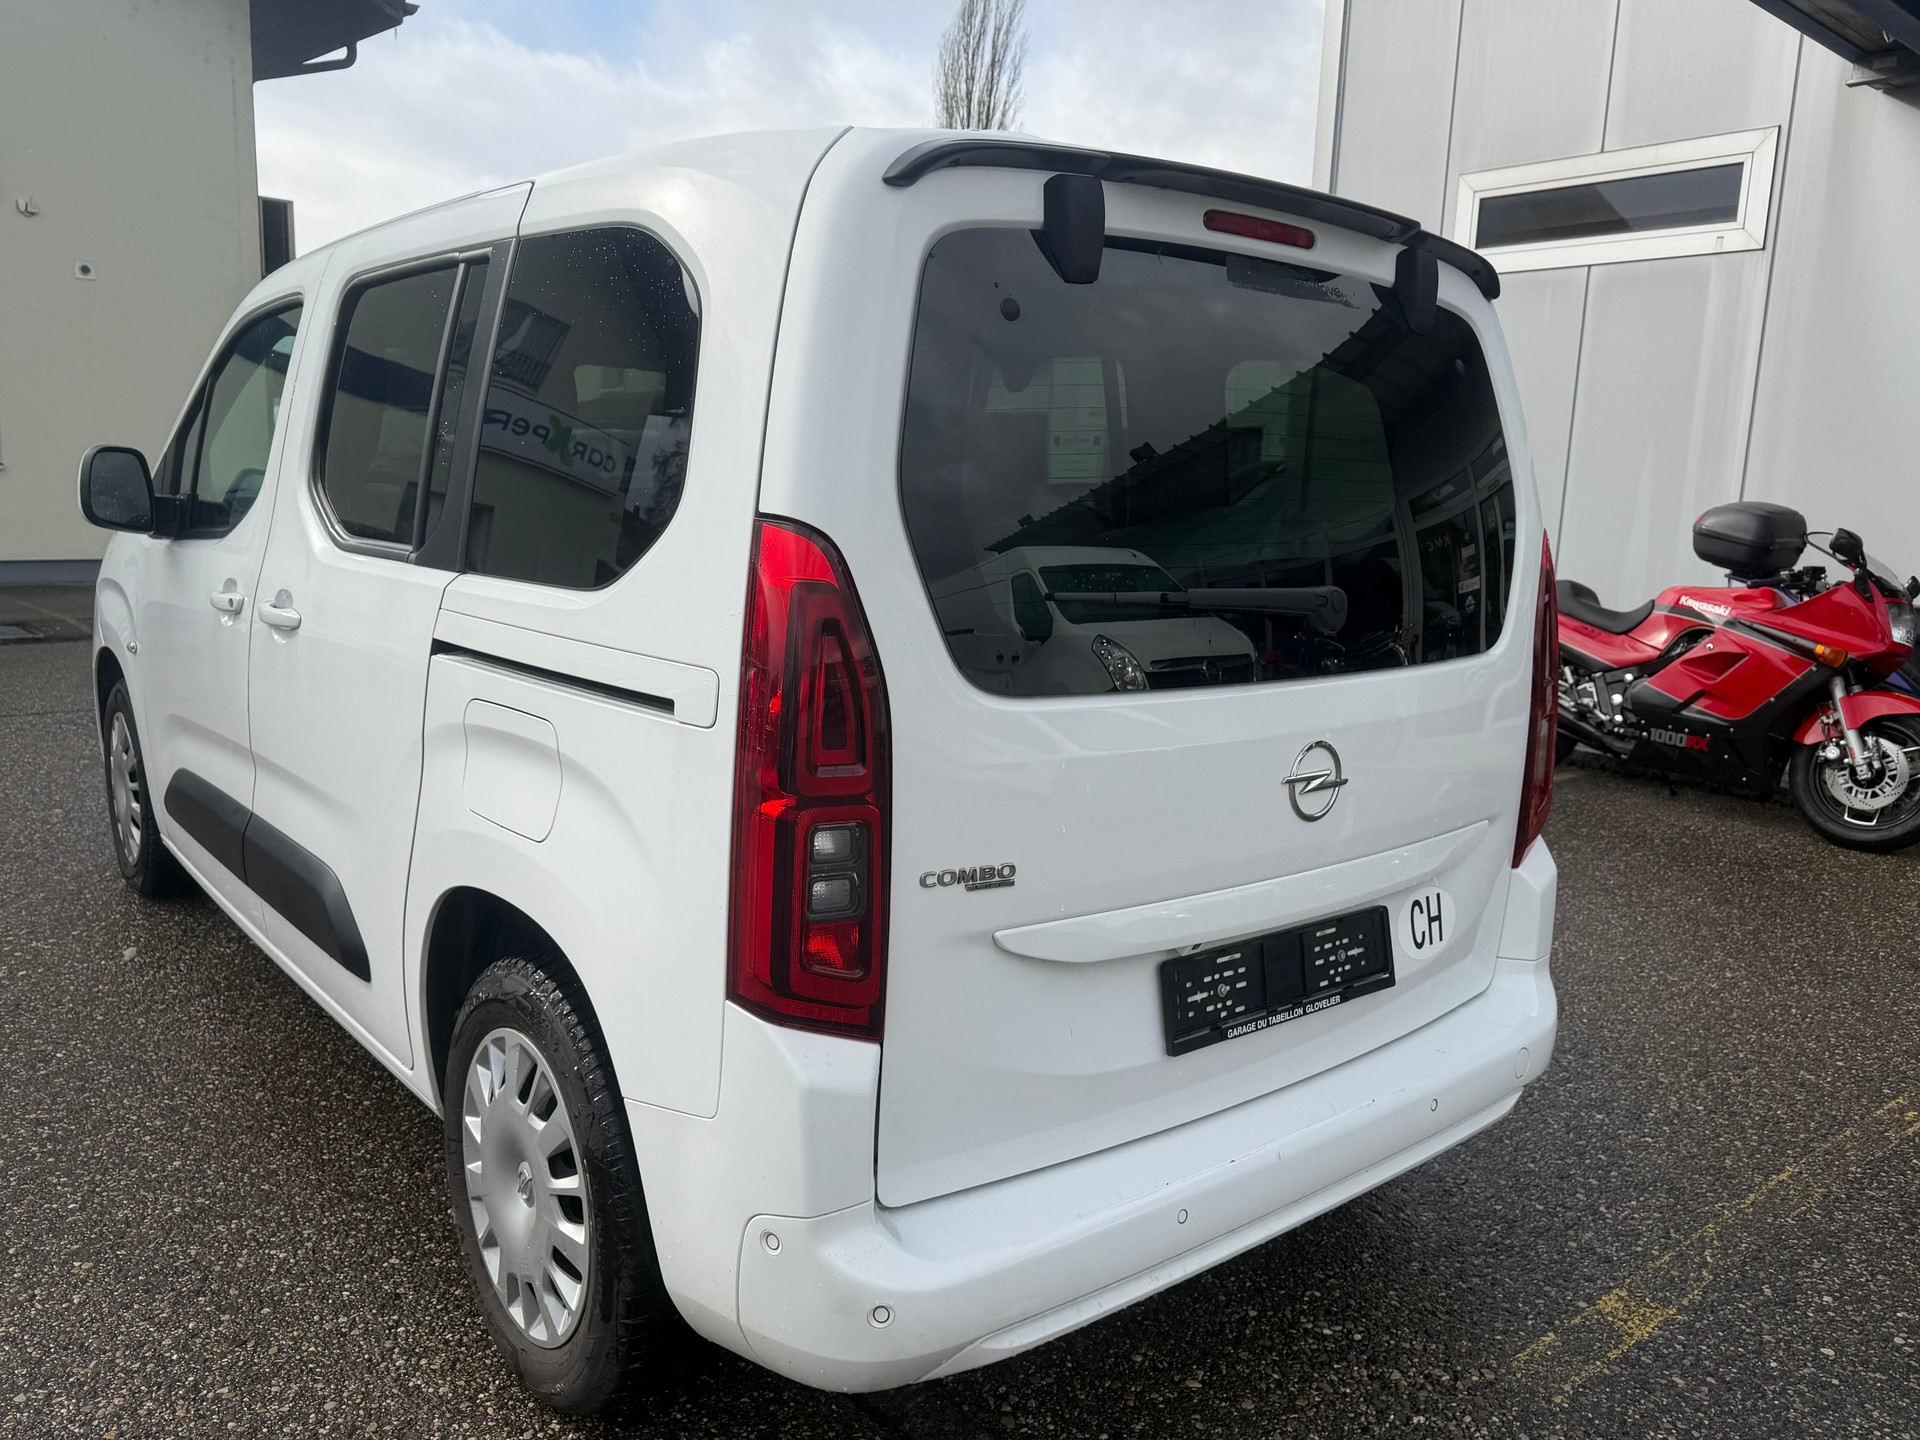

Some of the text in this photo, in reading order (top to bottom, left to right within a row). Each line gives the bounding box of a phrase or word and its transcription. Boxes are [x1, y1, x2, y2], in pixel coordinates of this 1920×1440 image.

[1679, 595, 1732, 616] Kawasaki
[919, 862, 1016, 888] COMBO
[1410, 892, 1443, 950] CH
[1227, 995, 1341, 1038] GARAGE DU TABEILLON GLOVELIER
